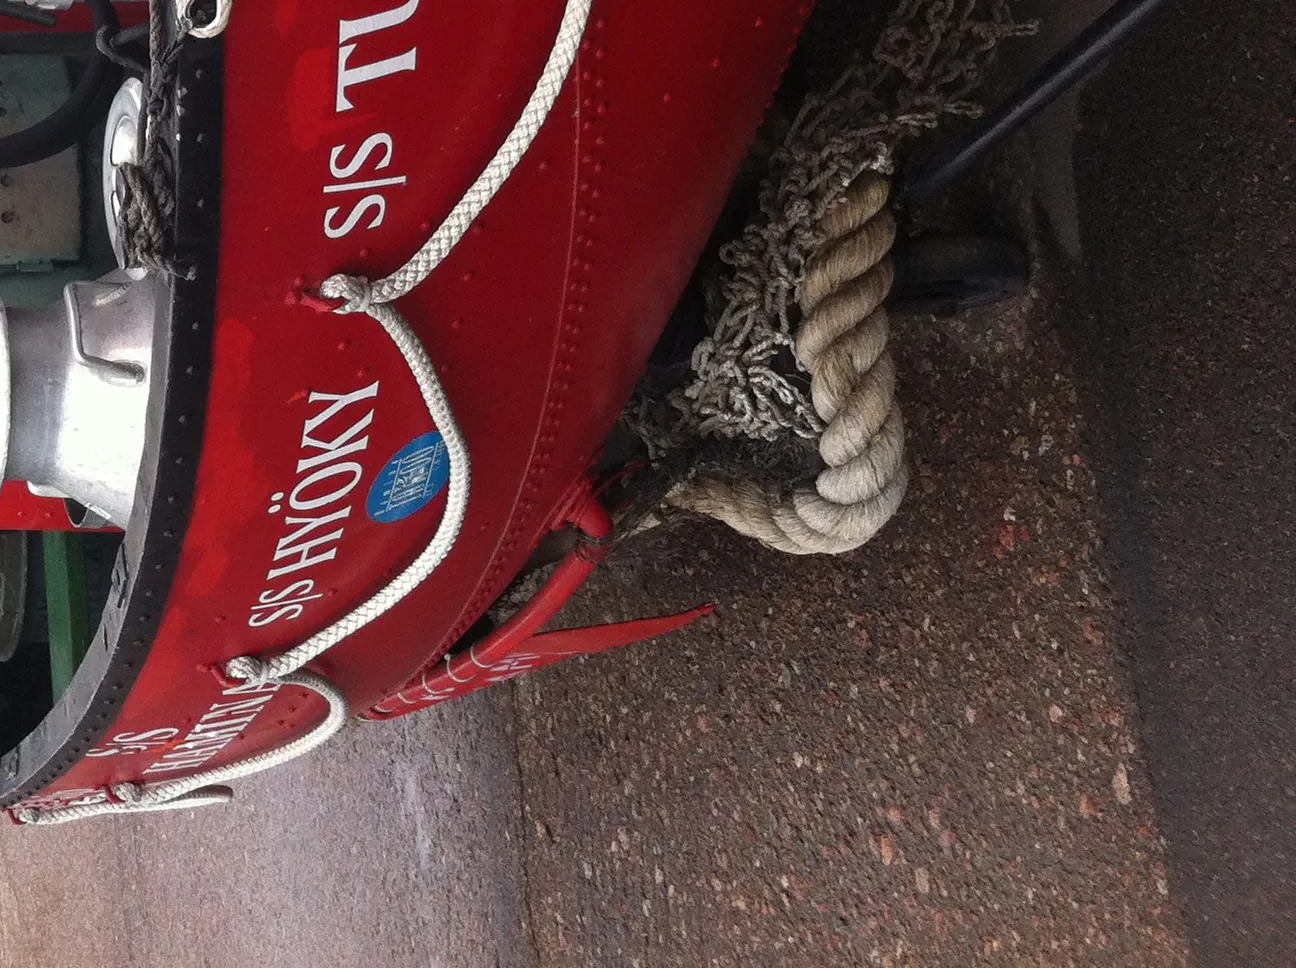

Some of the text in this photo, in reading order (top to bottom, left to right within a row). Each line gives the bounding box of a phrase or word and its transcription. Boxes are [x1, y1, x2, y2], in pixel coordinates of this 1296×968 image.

[323, 132, 407, 239] S/S
[248, 380, 379, 627] S/S HYÖKY
